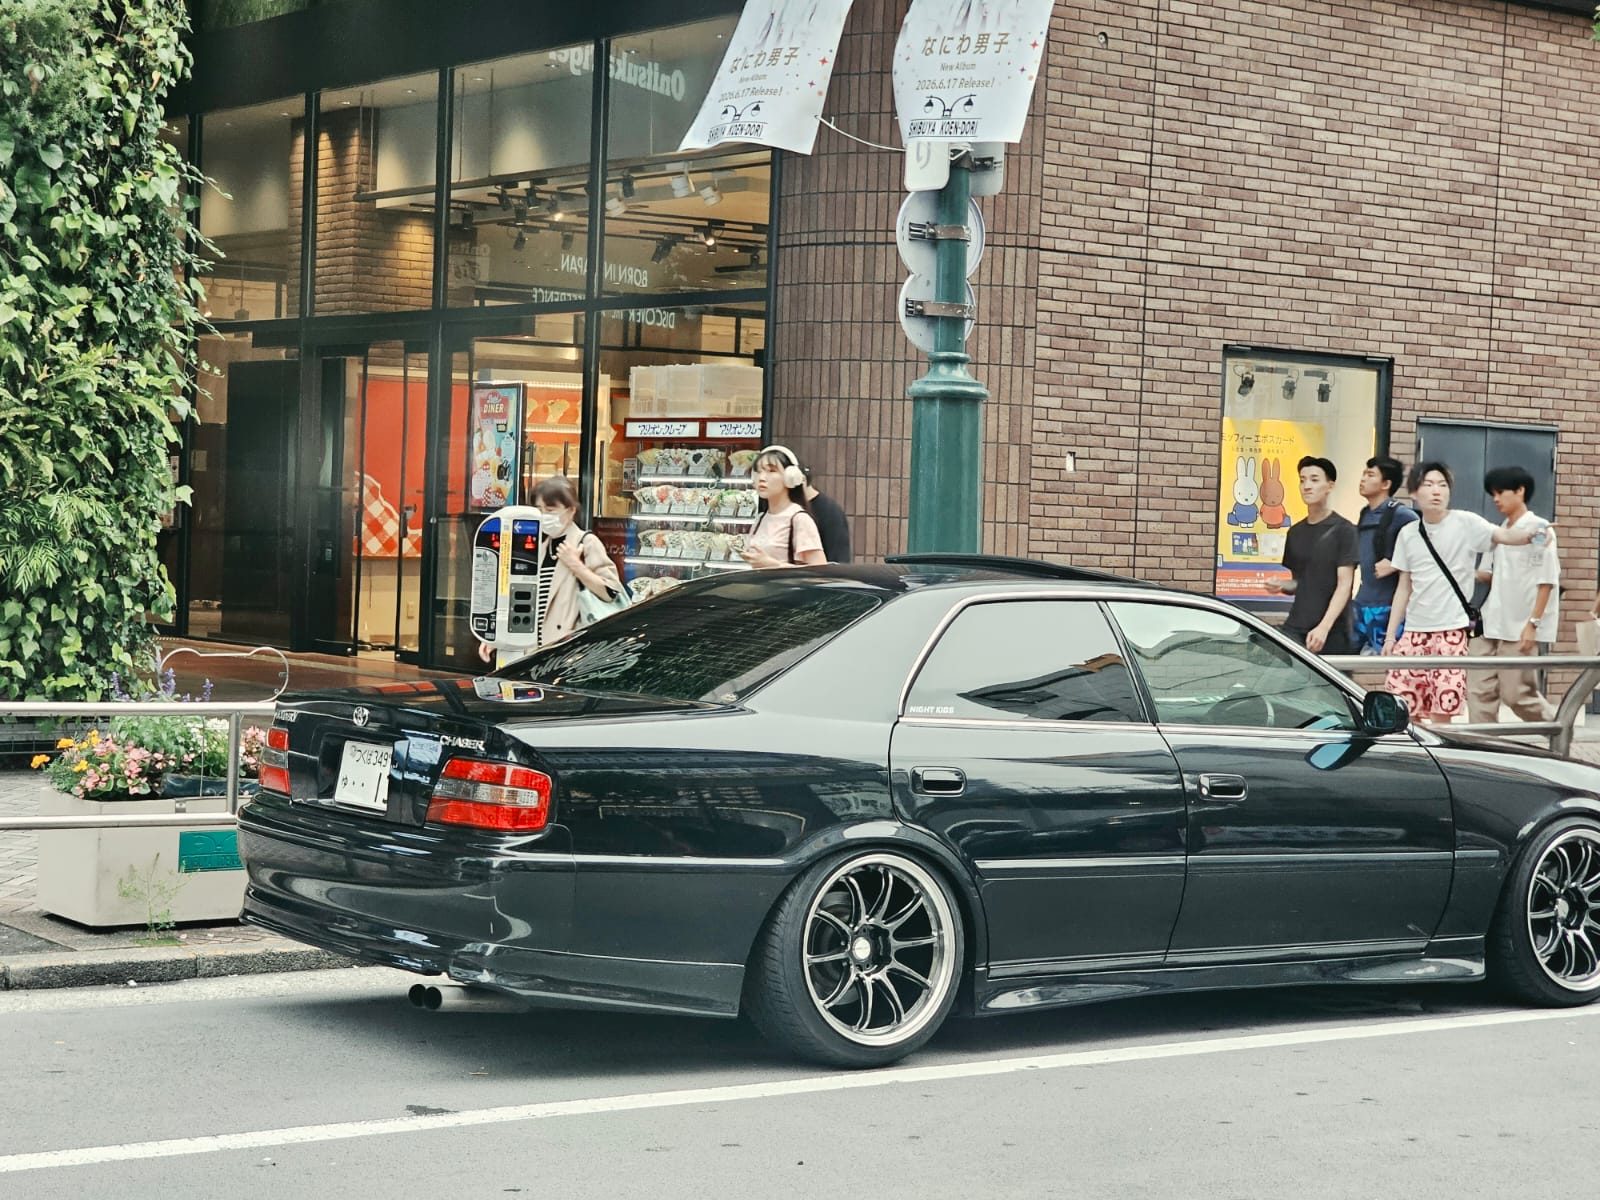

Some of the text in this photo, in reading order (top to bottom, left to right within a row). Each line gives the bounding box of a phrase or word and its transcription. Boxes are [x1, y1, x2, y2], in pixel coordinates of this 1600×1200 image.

[921, 32, 1010, 56] なにわ男子
[730, 46, 799, 74] なにわ男子
[940, 62, 976, 72] New Album
[915, 78, 957, 91] 2026.6.17
[908, 120, 978, 137] SHIBUYA KOEN-DORI
[483, 403, 505, 414] DINER
[909, 705, 934, 713] NIGHT
[440, 735, 486, 751] CHASER
